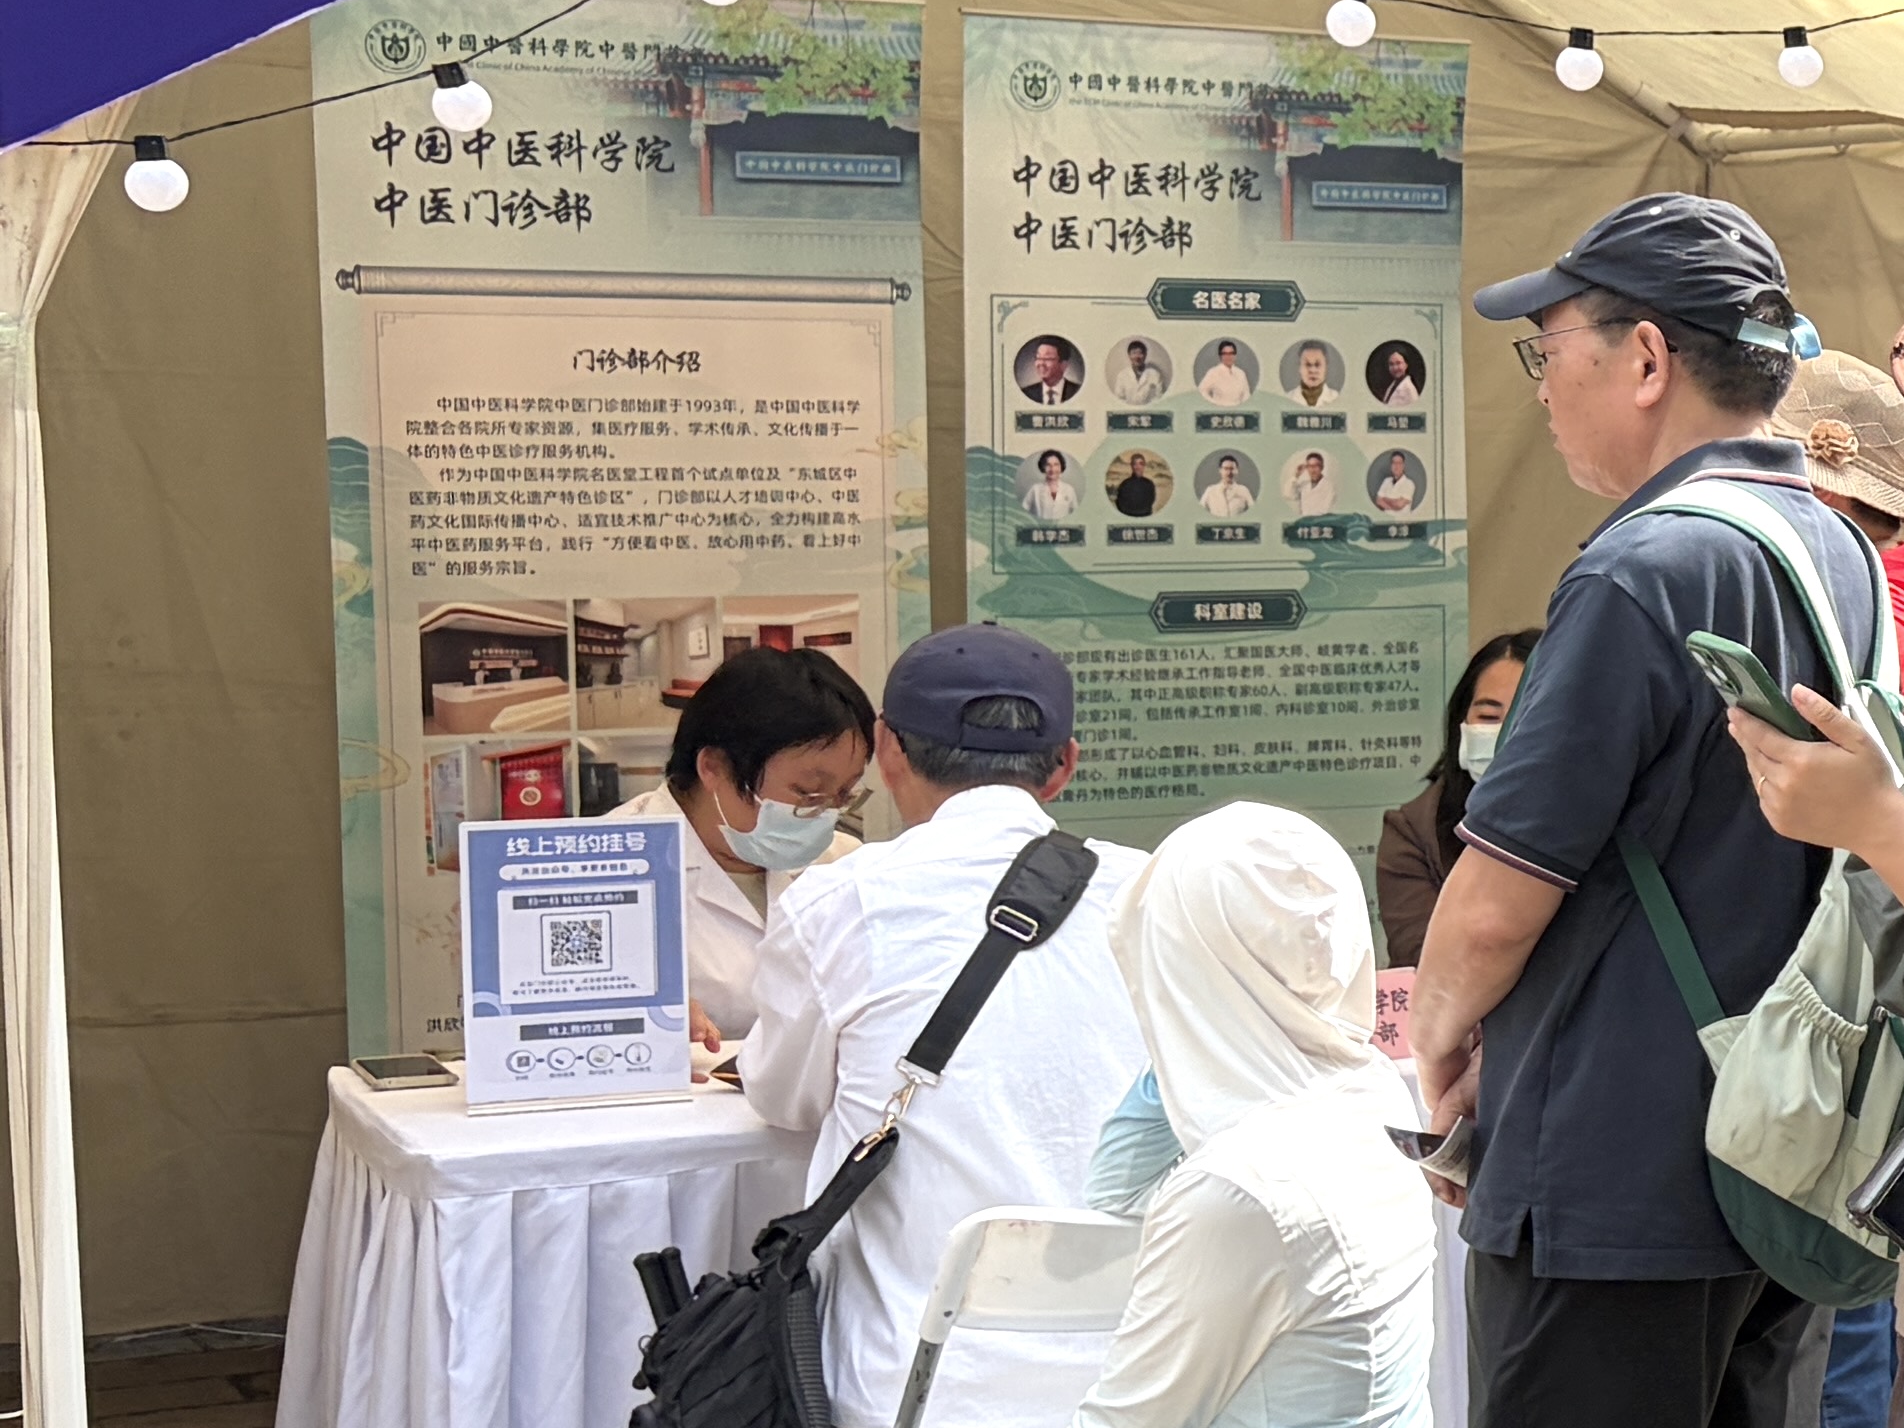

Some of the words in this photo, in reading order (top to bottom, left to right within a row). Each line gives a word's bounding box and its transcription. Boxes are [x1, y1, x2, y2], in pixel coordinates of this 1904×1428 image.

[371, 121, 675, 174] 中国中医科学院
[1011, 153, 1263, 203] 中国中医科学院
[372, 181, 594, 233] 中医门诊部
[1012, 211, 1195, 259] 中医门诊部
[1191, 290, 1262, 311] 名医名家
[572, 346, 701, 375] 门诊部介绍
[1194, 601, 1264, 622] 科室建设
[506, 831, 648, 858] 线上预约挂号
